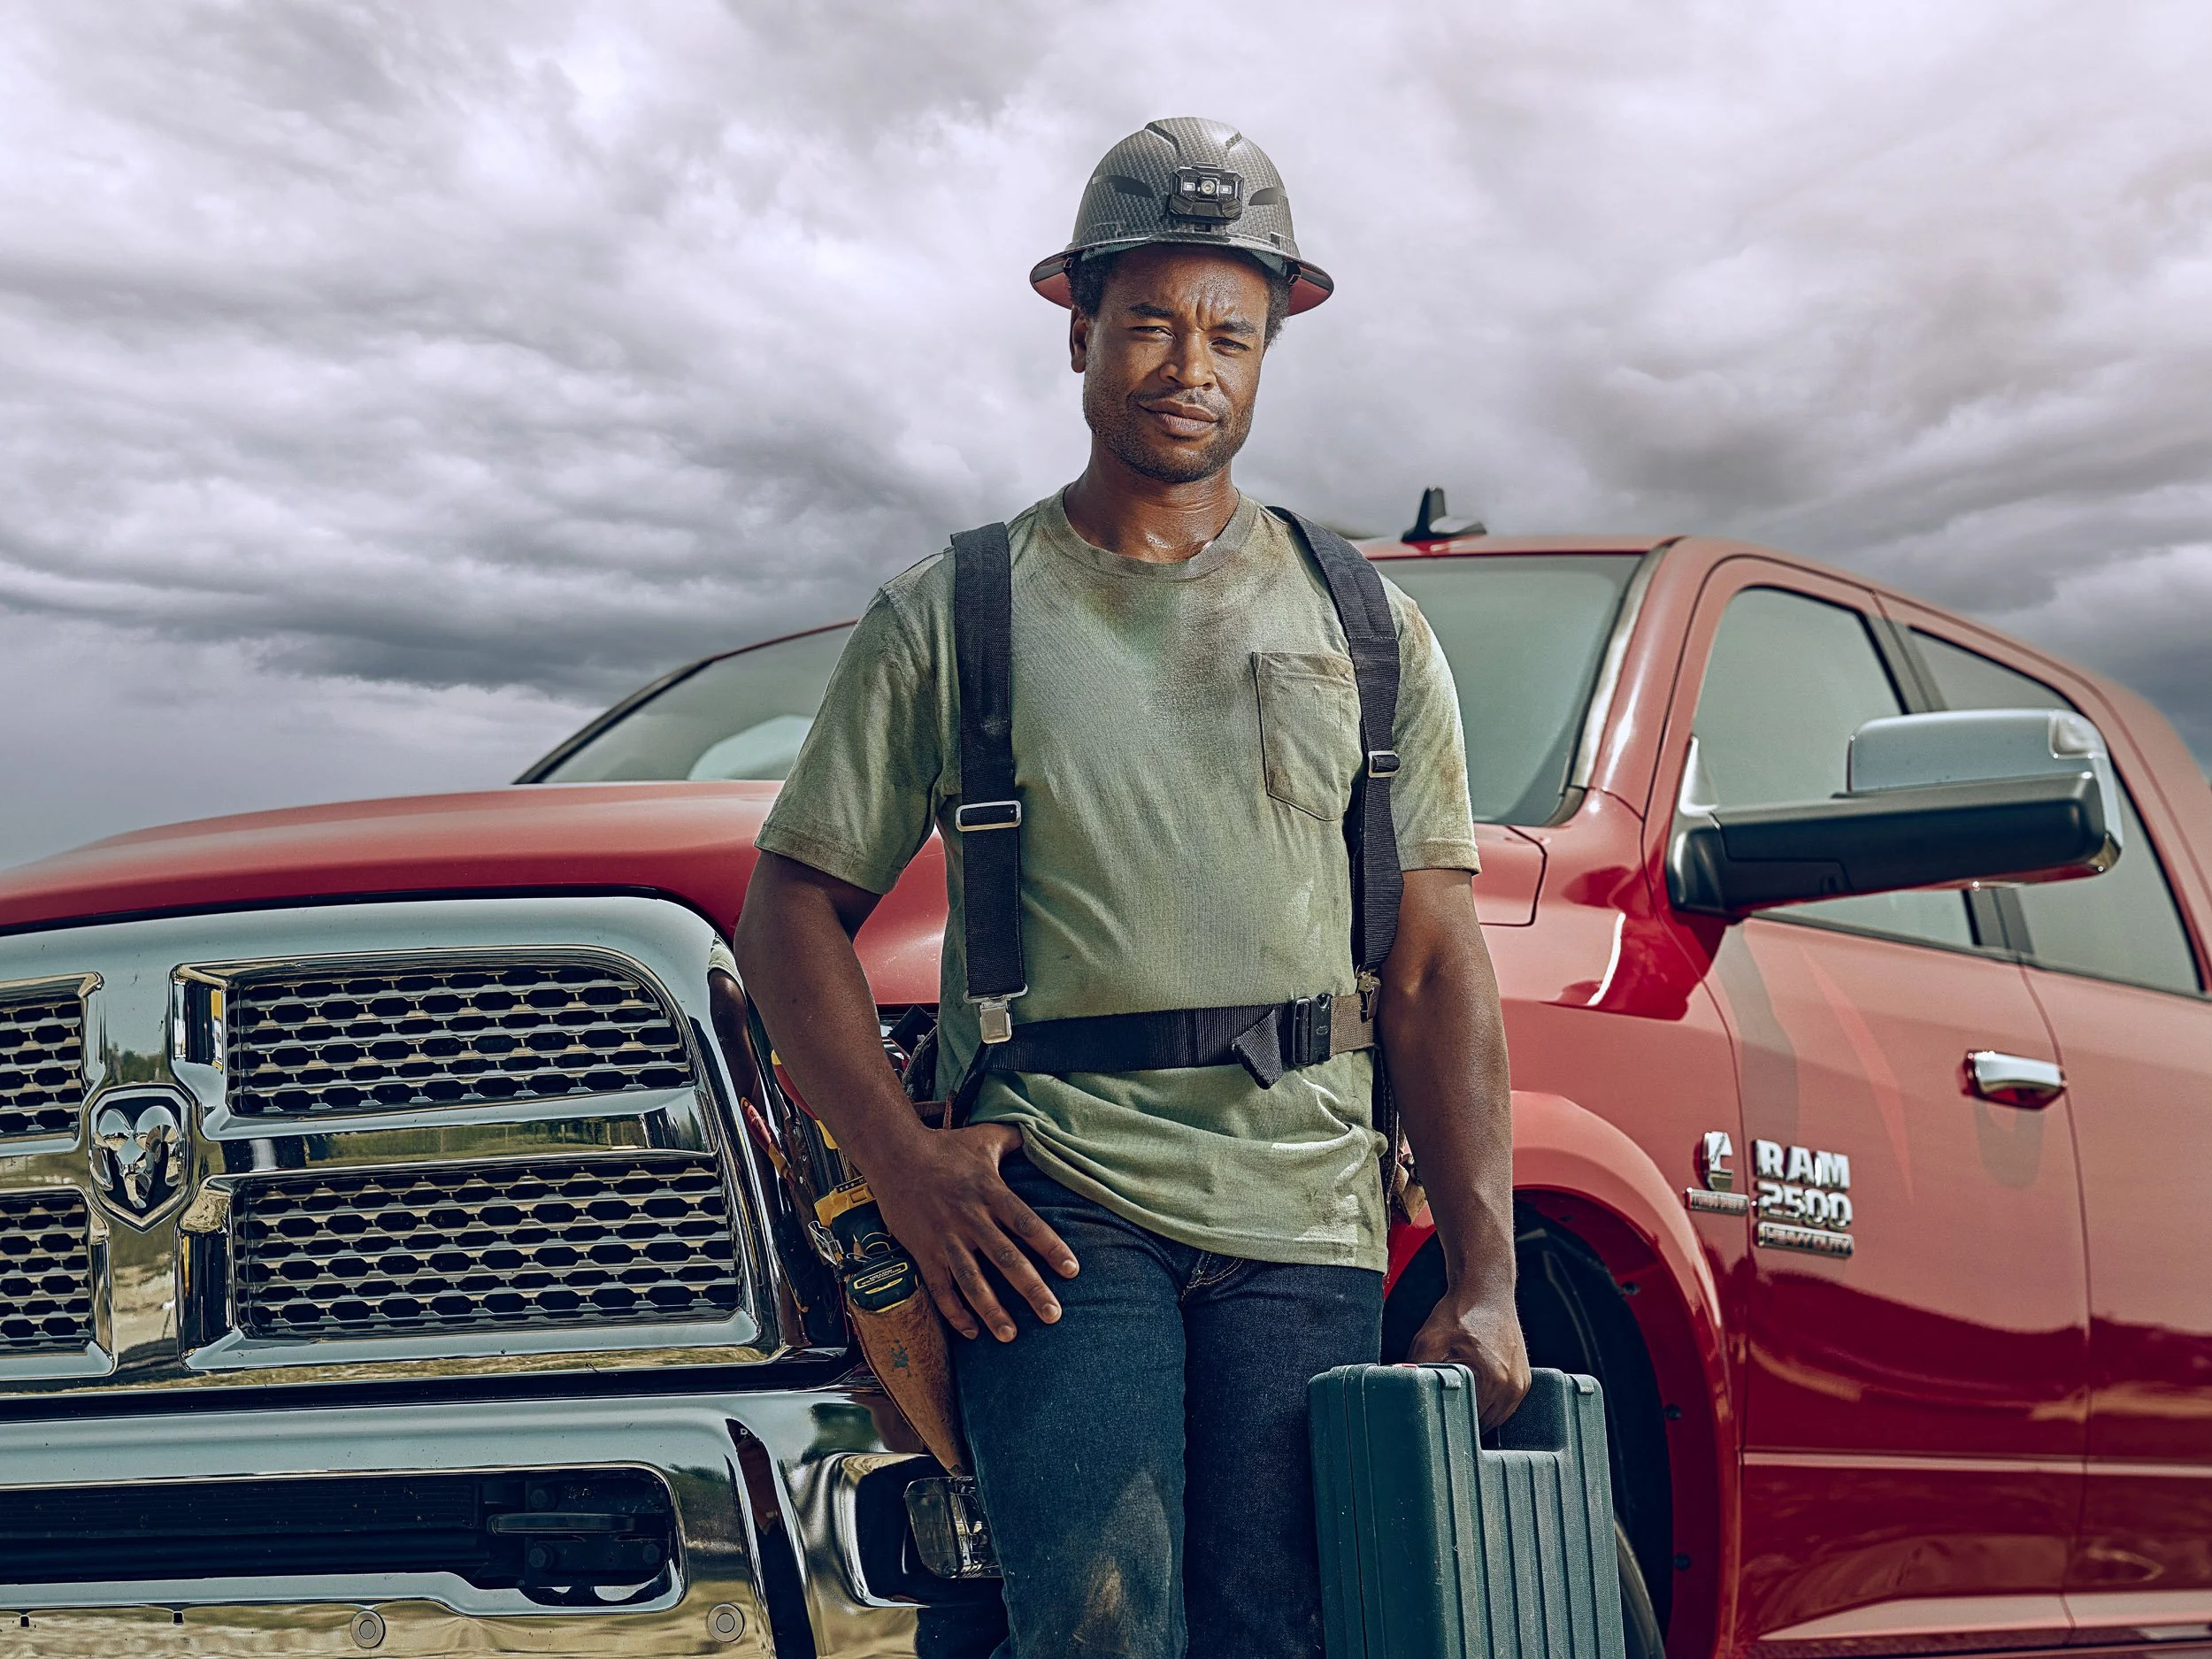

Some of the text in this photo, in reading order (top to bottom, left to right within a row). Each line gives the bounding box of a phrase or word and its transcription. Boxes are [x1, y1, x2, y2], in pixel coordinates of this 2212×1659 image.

[1754, 1139, 1851, 1189] RAM
[1757, 1180, 1853, 1231] 2500
[1765, 1226, 1853, 1254] HEAVY DUTY
